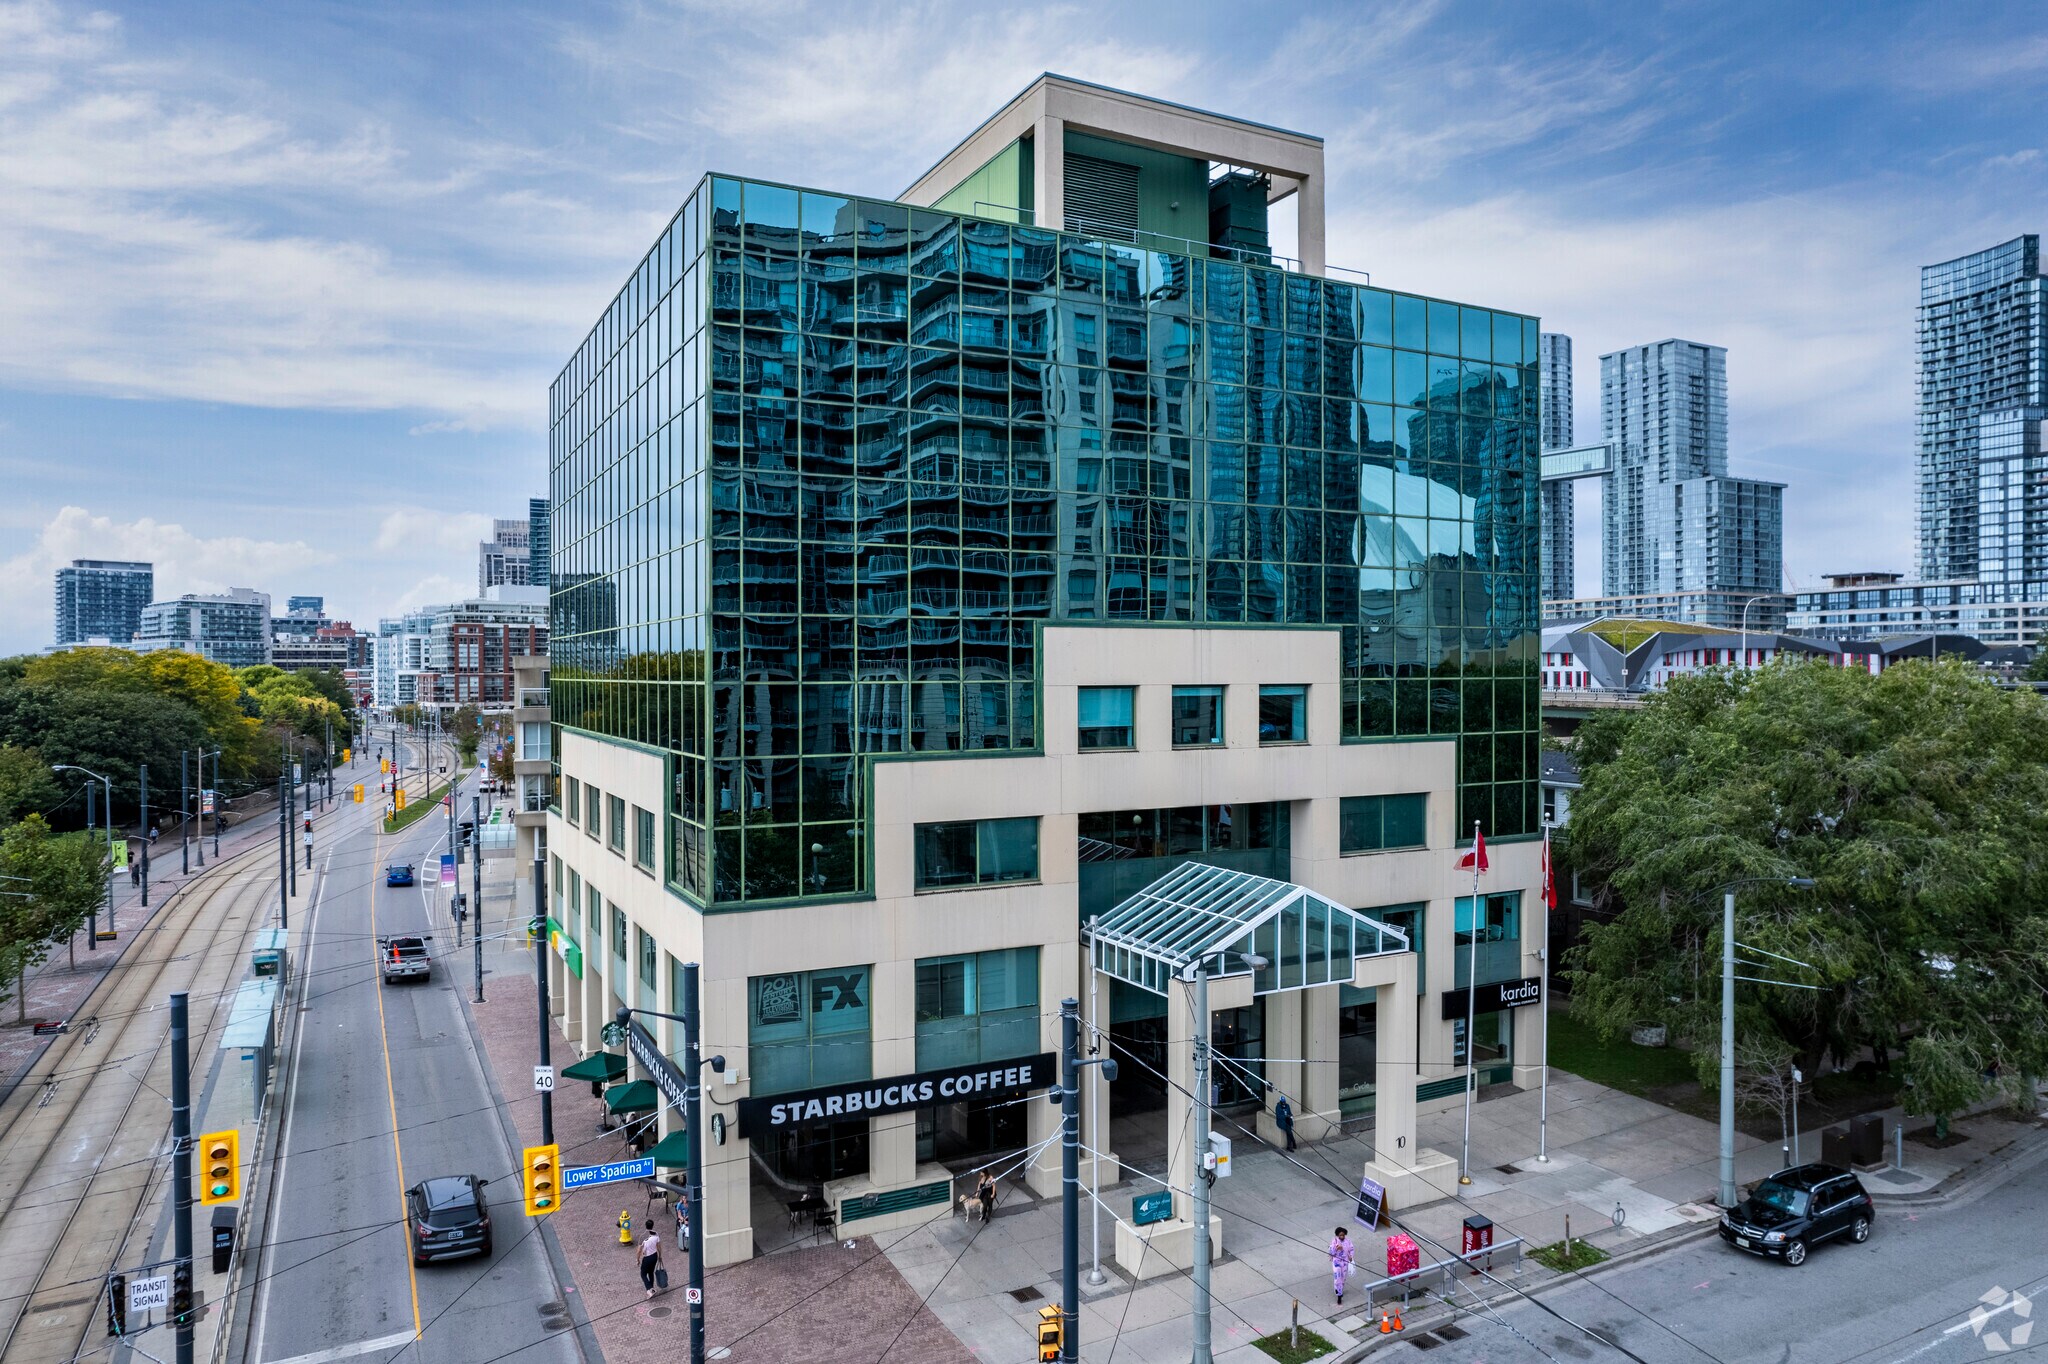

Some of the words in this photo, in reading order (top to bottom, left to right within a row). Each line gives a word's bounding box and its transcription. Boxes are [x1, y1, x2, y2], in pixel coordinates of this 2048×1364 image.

[764, 978, 793, 994] 20th
[813, 973, 864, 1013] FX
[1500, 981, 1539, 1002] kardia
[763, 987, 792, 1001] CENTURY
[763, 995, 792, 1008] FOX
[763, 1002, 794, 1014] TELEVISION
[631, 1032, 664, 1085] STARBUCKS
[536, 1076, 553, 1088] 40
[1353, 1082, 1370, 1092] Cycle
[770, 1080, 933, 1125] STARBUCKS
[939, 1065, 1032, 1098] COFFEE
[1396, 1136, 1406, 1149] 10
[567, 1169, 598, 1183] Lower
[600, 1163, 642, 1180] Spadina
[1363, 1179, 1382, 1196] kardia
[131, 1280, 167, 1295] TRANSIT
[133, 1293, 165, 1307] SIGNAL
